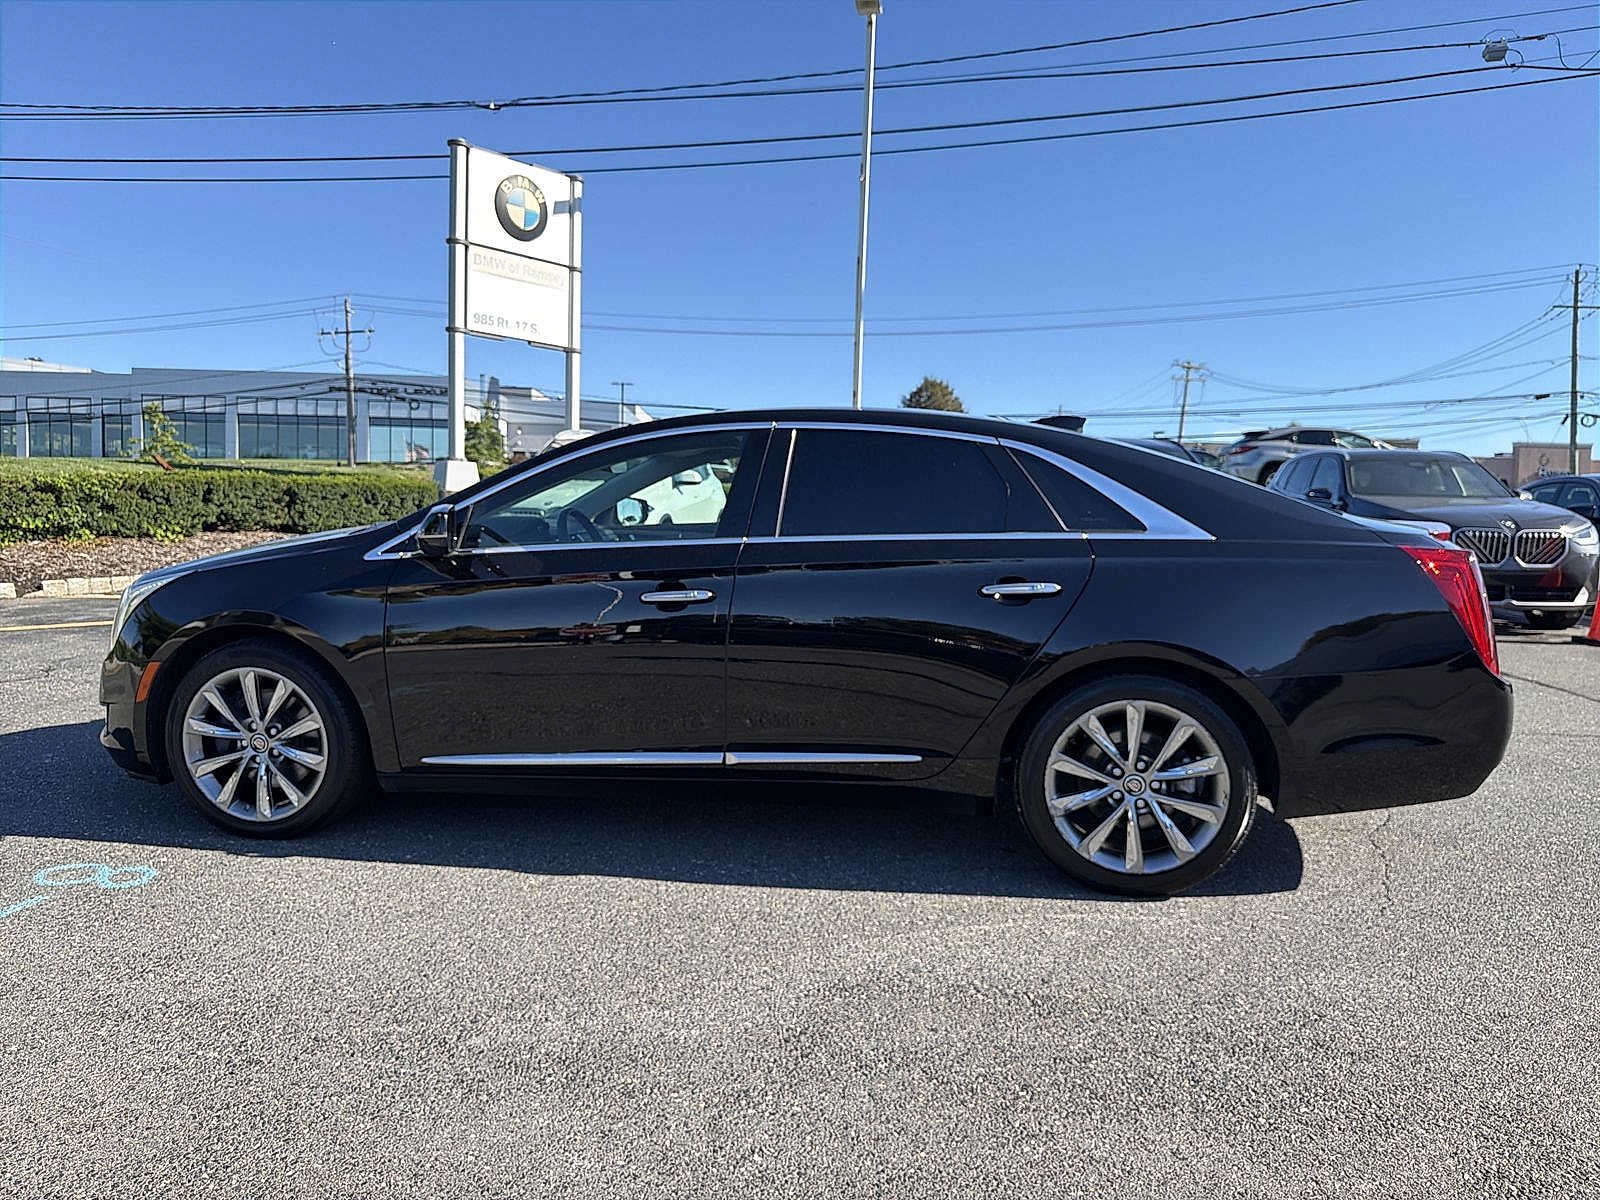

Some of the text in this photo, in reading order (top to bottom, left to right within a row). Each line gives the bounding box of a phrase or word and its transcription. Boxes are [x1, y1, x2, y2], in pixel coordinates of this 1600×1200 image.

[499, 175, 546, 204] BMW
[473, 252, 507, 272] BMW
[508, 262, 519, 275] of
[473, 312, 495, 327] 985
[515, 320, 528, 332] 17
